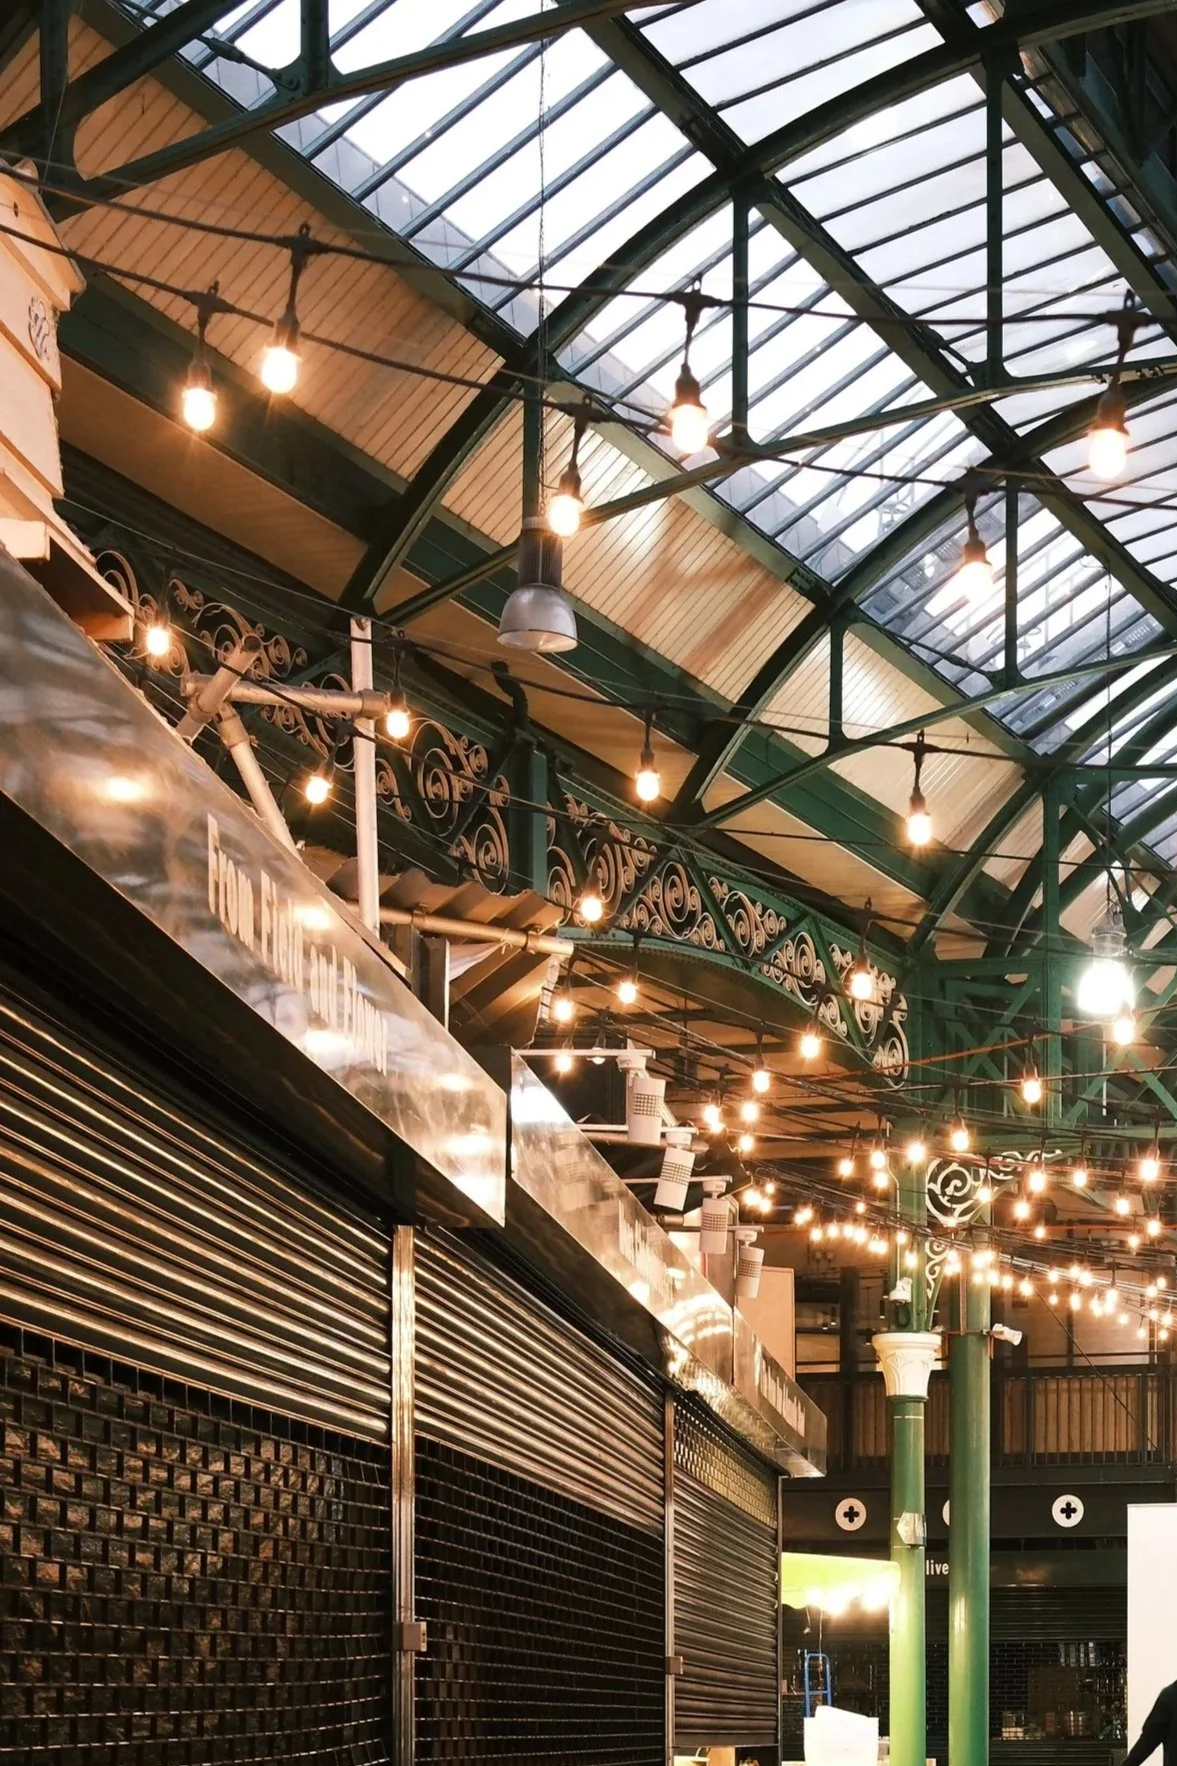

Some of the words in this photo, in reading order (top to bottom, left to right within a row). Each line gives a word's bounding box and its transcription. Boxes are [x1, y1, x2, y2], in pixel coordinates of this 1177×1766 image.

[207, 813, 254, 951] From
[261, 870, 303, 996] Field
[310, 944, 337, 1034] and
[343, 956, 388, 1077] Flower
